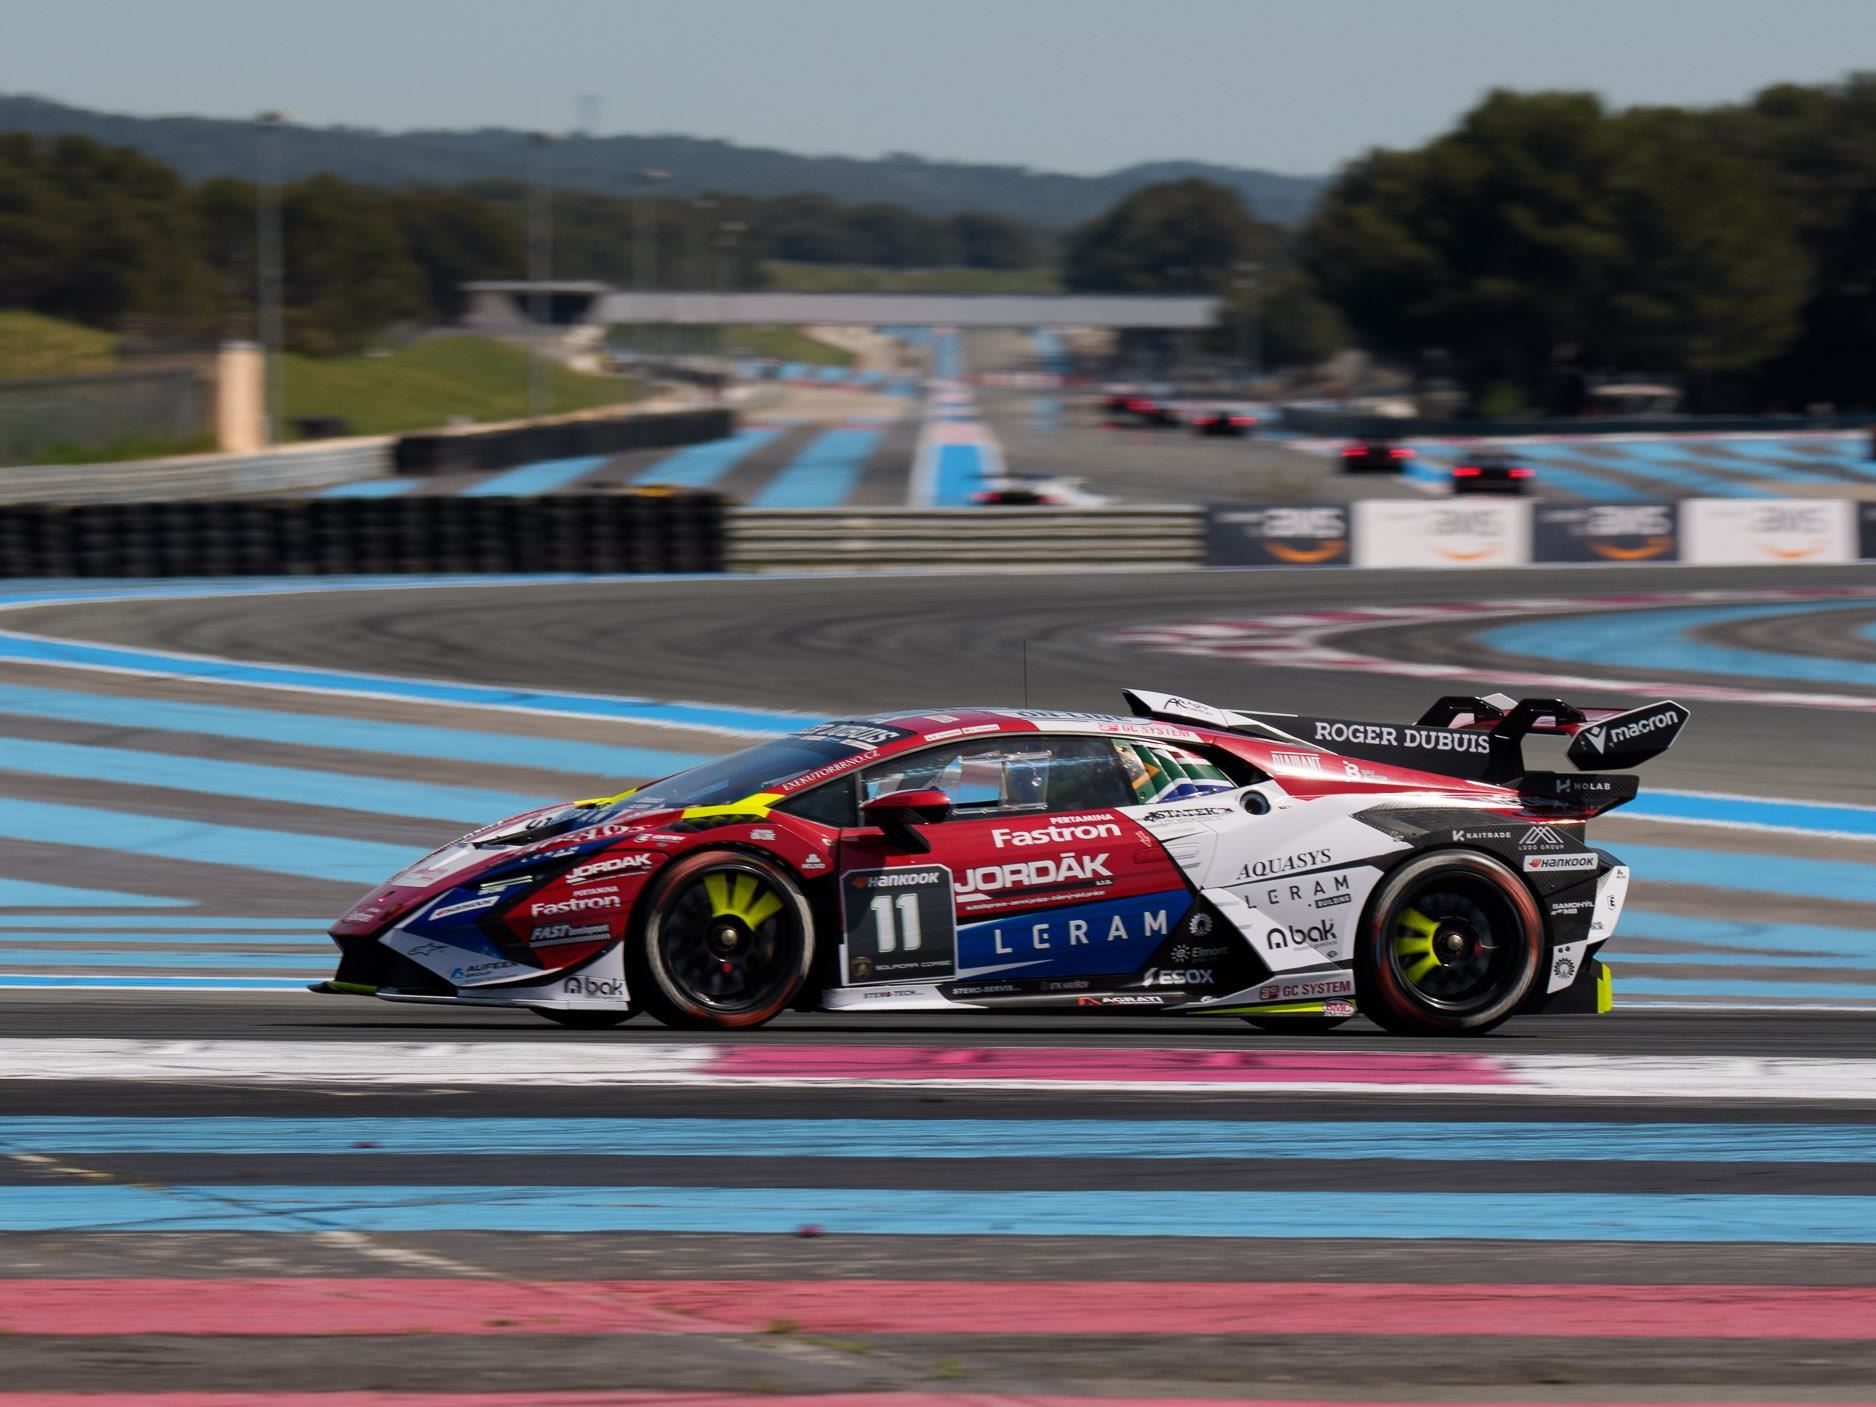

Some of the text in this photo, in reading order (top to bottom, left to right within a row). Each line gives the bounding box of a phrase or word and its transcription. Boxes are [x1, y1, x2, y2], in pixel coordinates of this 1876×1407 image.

[1315, 722, 1490, 754] ROGER DUBUIS
[1610, 711, 1679, 742] macron
[1049, 813, 1114, 825] PERTAMINA
[992, 823, 1122, 848] Fastron
[1466, 831, 1511, 839] KAITRADE
[1236, 848, 1332, 880] AQUASYS
[531, 894, 621, 917] Fastron
[1245, 875, 1350, 909] LERAM
[870, 892, 922, 953] 11
[994, 909, 1168, 954] LERAM
[1159, 969, 1214, 985] ESOX
[1283, 980, 1351, 997] GC SYSTEM
